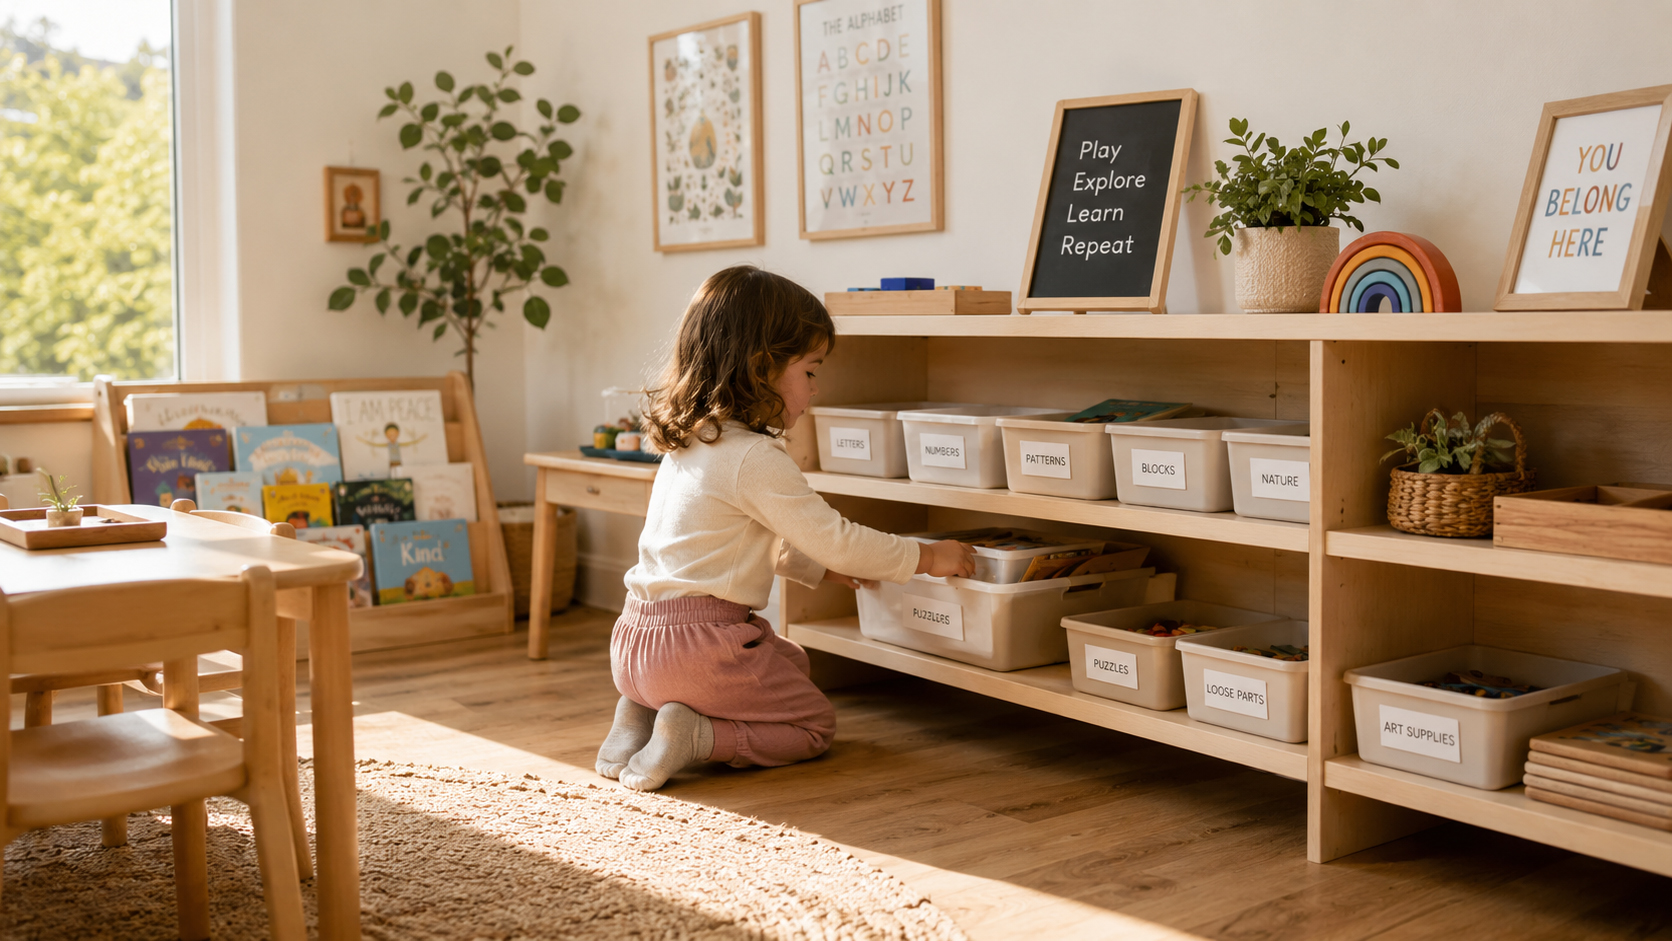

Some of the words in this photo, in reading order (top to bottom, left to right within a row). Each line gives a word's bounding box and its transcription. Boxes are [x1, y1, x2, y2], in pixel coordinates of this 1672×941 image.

[822, 18, 842, 36] THE
[848, 4, 904, 31] ALPHABET
[1079, 140, 1122, 164] Play
[1577, 142, 1624, 174] YOU
[1073, 170, 1146, 196] Explore
[1545, 182, 1632, 217] BELONG
[1067, 204, 1124, 223] Learn
[1061, 235, 1134, 261] Repeat
[1548, 227, 1608, 258] HERE
[388, 395, 436, 422] PEACE
[836, 438, 864, 450] LETTERS
[925, 446, 960, 458] NUMBERS
[1026, 454, 1066, 467] PATTERNS
[1142, 462, 1176, 476] BLOCKS
[1261, 474, 1299, 487] NATURE
[400, 540, 444, 566] Kind
[1093, 658, 1129, 675] PUZZLES
[1206, 684, 1234, 698] LOOSE
[1238, 690, 1264, 705] PARTS
[1384, 722, 1404, 734] ART
[1406, 726, 1455, 746] SUPPLIES
